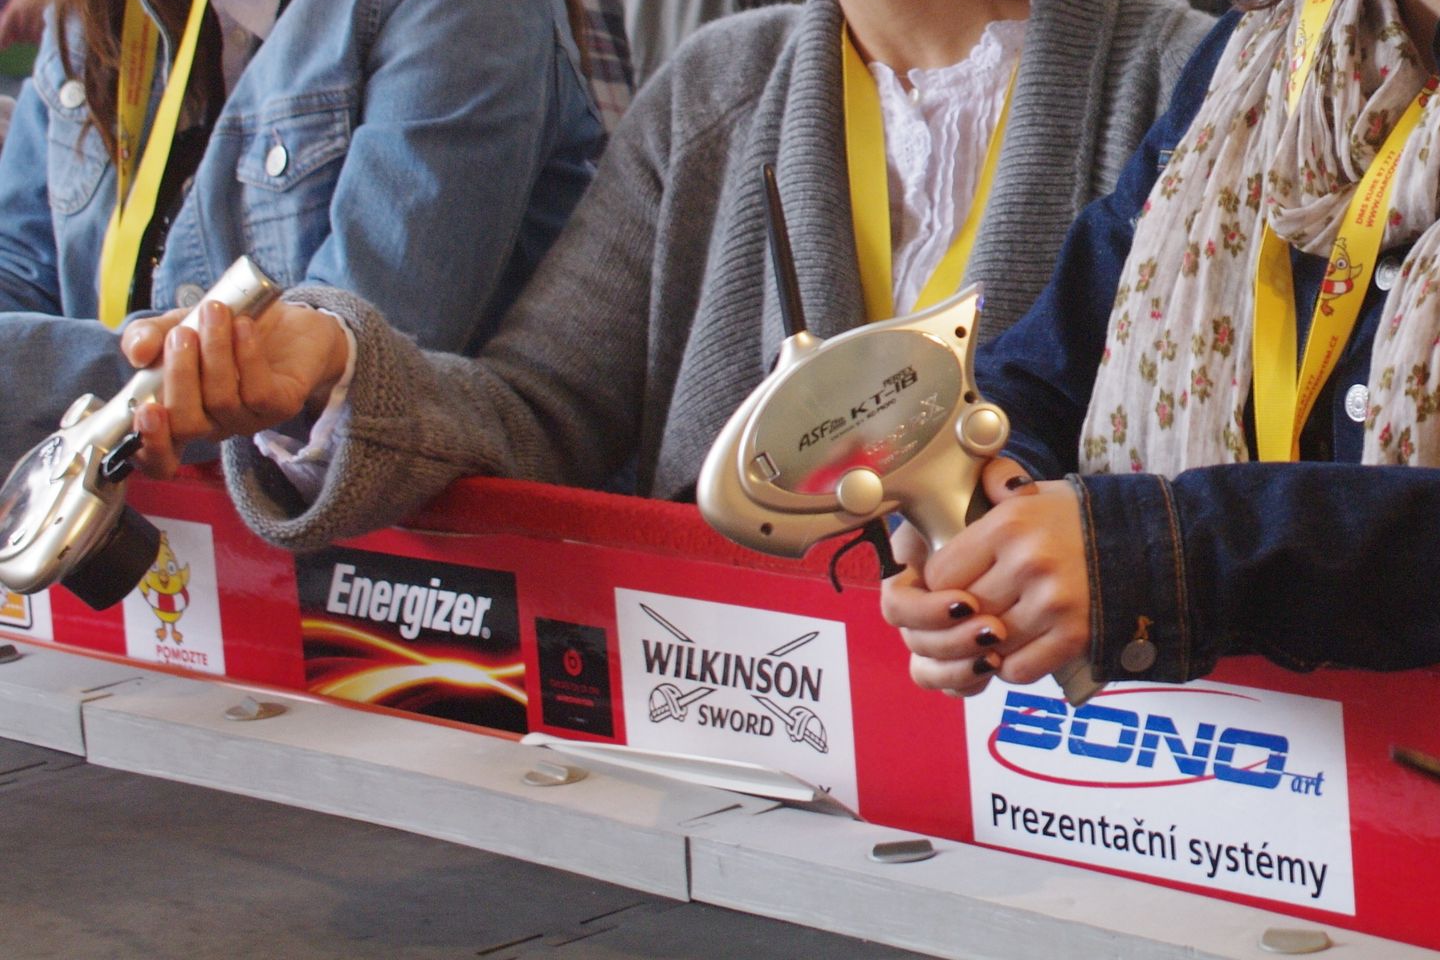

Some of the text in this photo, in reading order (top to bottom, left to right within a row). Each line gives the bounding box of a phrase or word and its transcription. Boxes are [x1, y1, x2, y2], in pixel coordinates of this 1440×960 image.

[156, 645, 208, 666] POMOZTE
[642, 639, 823, 702] WILKINSON
[697, 704, 774, 737] SWORD
[996, 690, 1325, 796] BONO art
[991, 793, 1328, 899] Prezentační systémy
